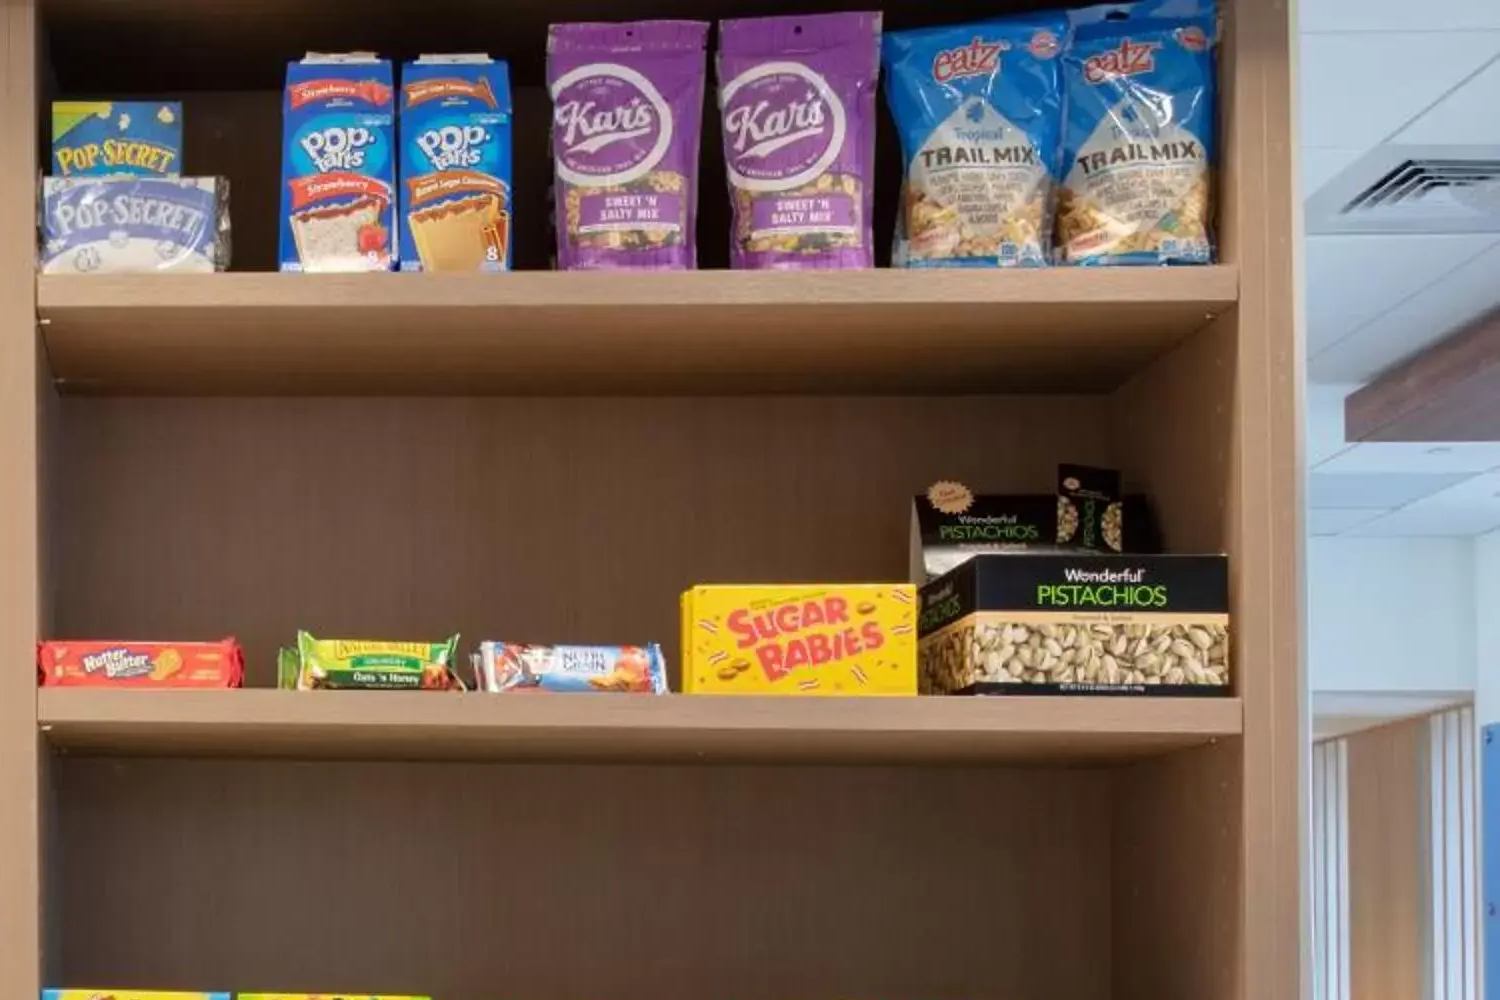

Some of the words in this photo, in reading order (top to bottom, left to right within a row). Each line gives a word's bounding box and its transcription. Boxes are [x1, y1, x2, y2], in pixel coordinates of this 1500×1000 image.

[301, 83, 356, 97] Strawberry
[555, 97, 652, 145] Kar's
[726, 91, 825, 152] Kar's
[100, 139, 176, 173] SECRET
[920, 147, 990, 168] TRAIL
[994, 145, 1034, 165] MIX
[1077, 142, 1150, 173] TRAIL
[1153, 140, 1197, 161] MIX
[307, 178, 368, 193] Strawberry
[605, 196, 642, 207] SWEET
[777, 200, 814, 211] SWEET
[111, 195, 202, 234] SECRET
[600, 208, 632, 220] SALTY
[637, 208, 659, 219] MIX
[771, 212, 806, 224] SALTY
[809, 211, 831, 223] MIX
[485, 247, 499, 261] 8
[958, 514, 1017, 526] Wonderful
[939, 525, 1039, 540] PISTACHIOS
[1064, 568, 1143, 583] Wonderful
[1037, 586, 1168, 607] PISTACHIOS
[727, 596, 850, 650] SUGAR
[756, 621, 885, 683] BABIES
